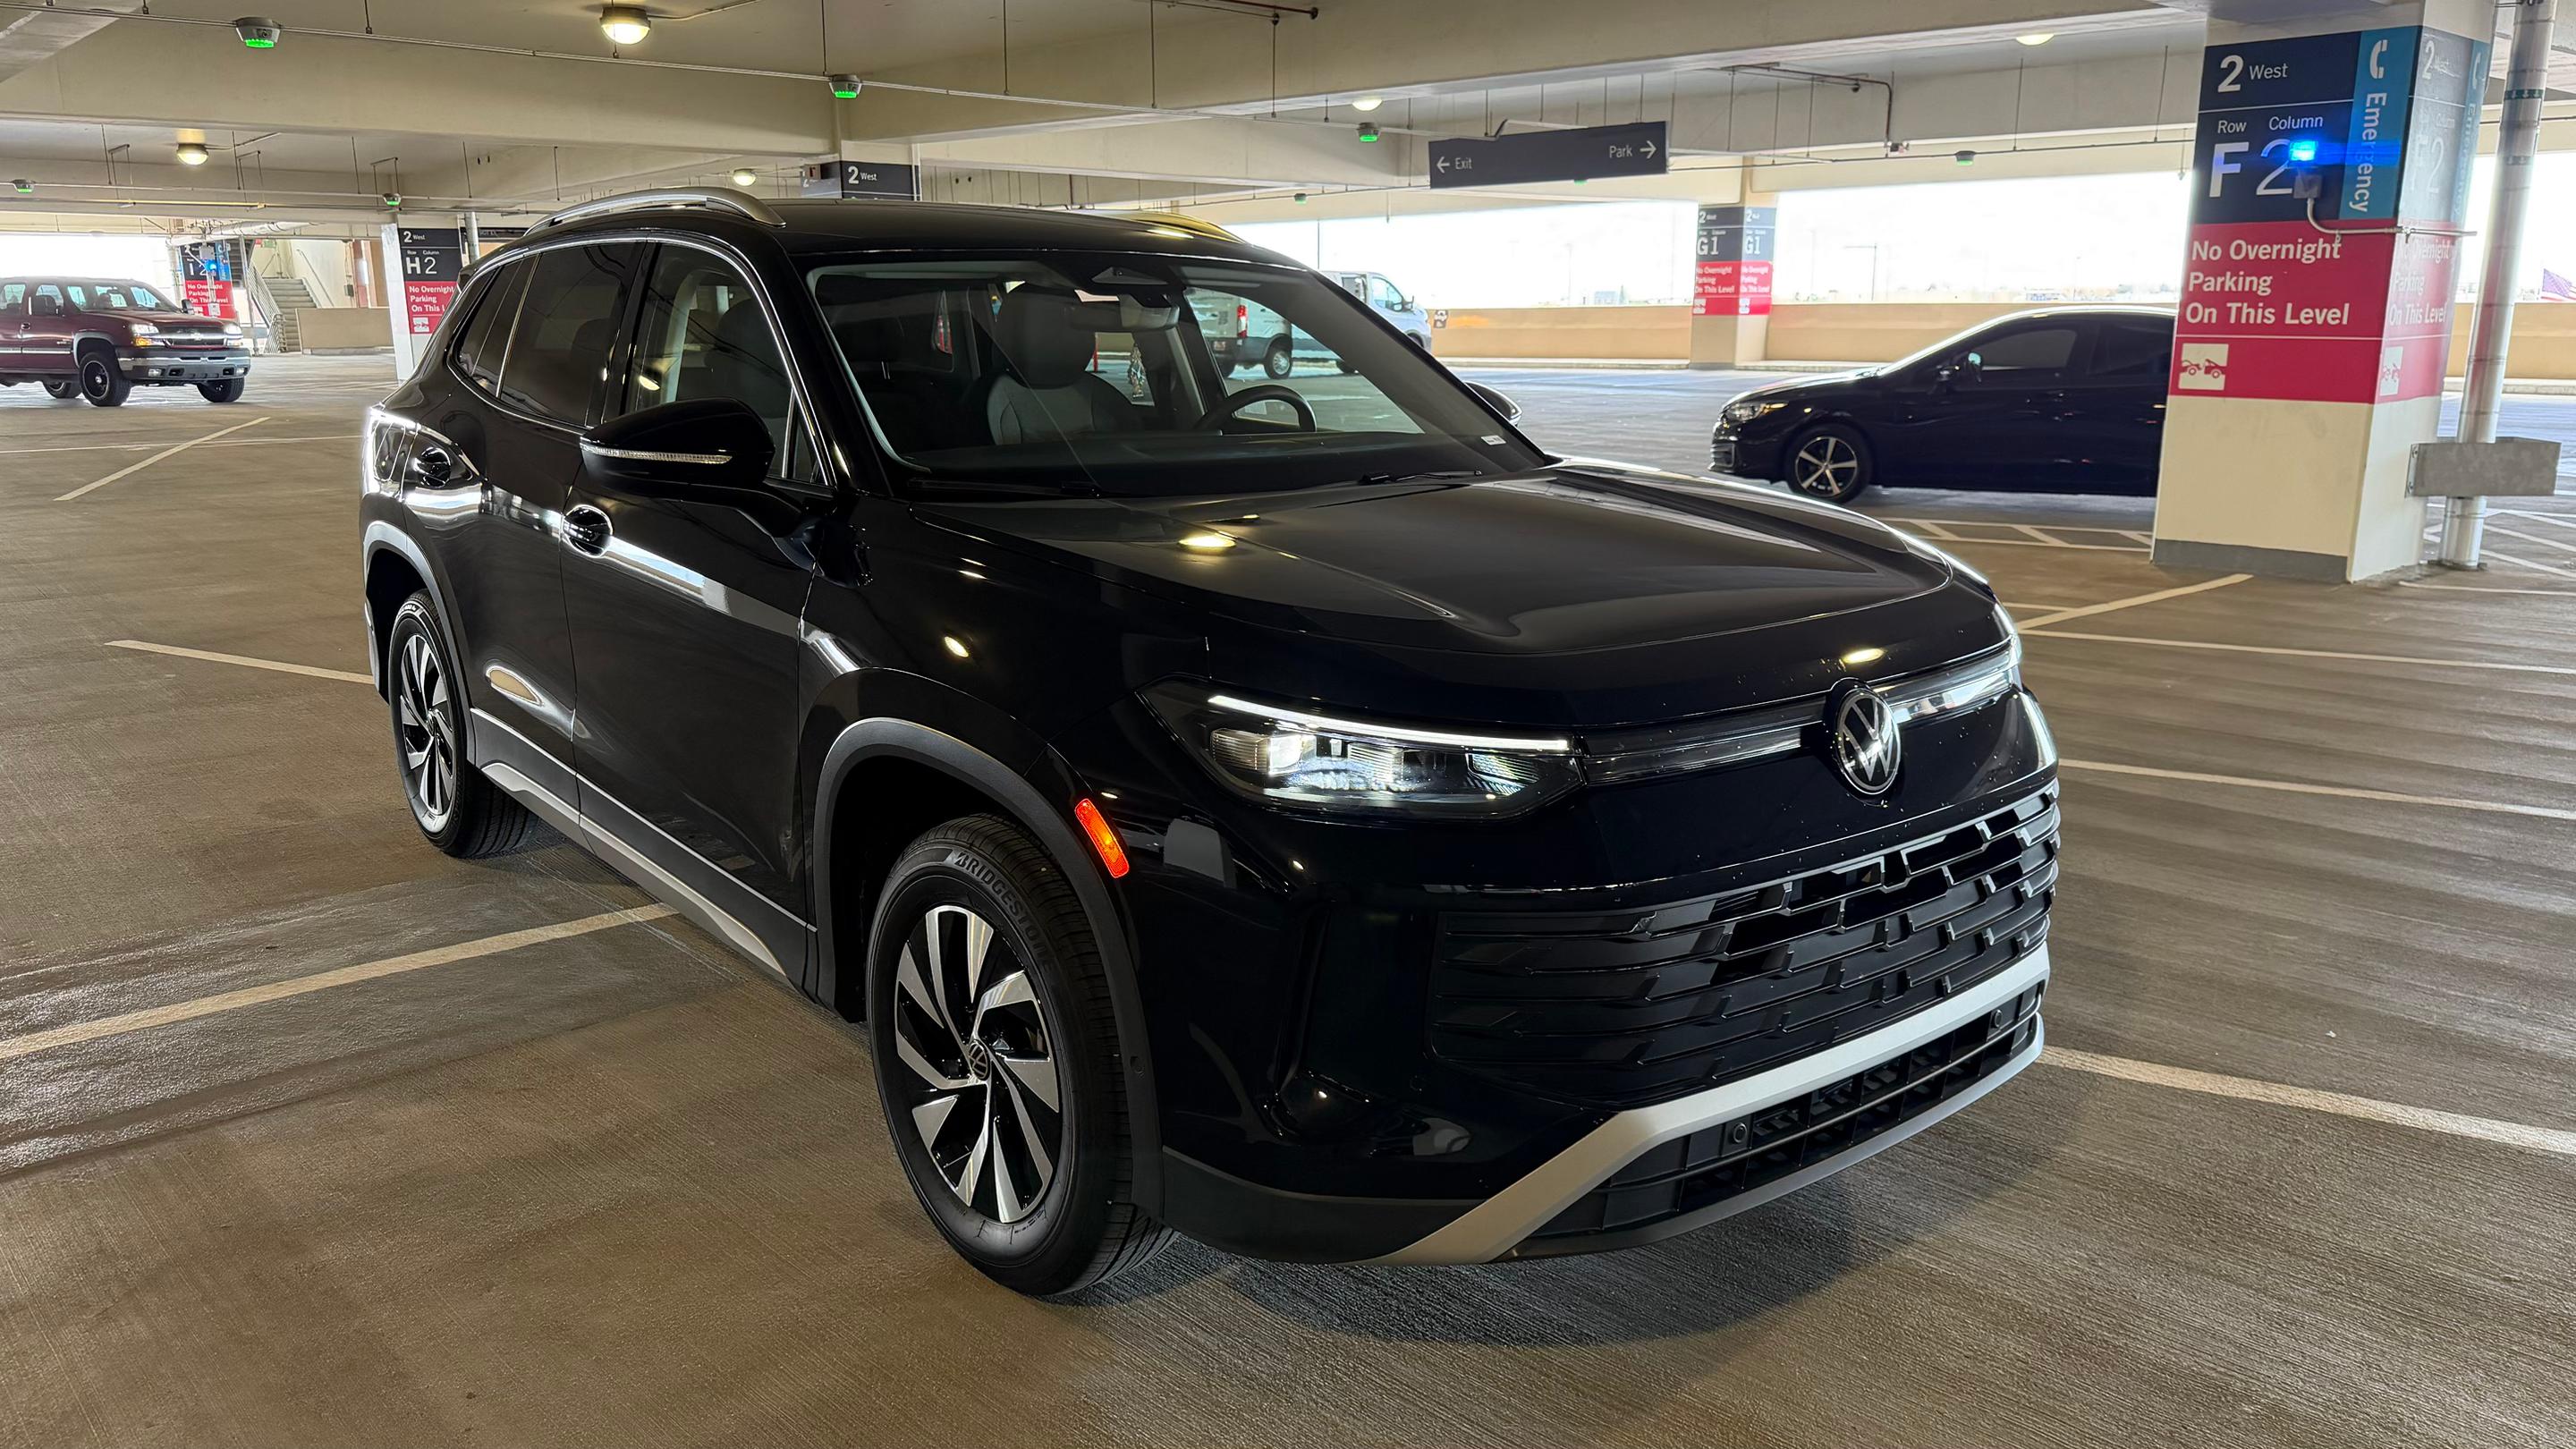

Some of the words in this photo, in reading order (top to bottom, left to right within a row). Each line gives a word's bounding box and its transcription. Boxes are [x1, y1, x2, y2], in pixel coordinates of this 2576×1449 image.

[2422, 40, 2435, 80] 2
[2217, 55, 2244, 93] 2
[2249, 64, 2289, 80] West
[2217, 121, 2247, 133] Row
[2268, 115, 2324, 131] Column
[1609, 145, 1633, 158] Park
[2349, 92, 2387, 212] Emergency
[1455, 157, 1472, 170] Exit
[2209, 141, 2250, 198] F
[848, 165, 859, 184] 2
[860, 172, 877, 181] West
[1699, 210, 1707, 224] 2
[403, 231, 412, 242] 2
[2192, 240, 2222, 260] No
[2229, 237, 2342, 264] Overnight
[405, 257, 421, 275] H
[424, 257, 437, 275] 2
[409, 285, 419, 293] No
[420, 285, 454, 294] Overnight
[2188, 271, 2273, 296] Parking
[411, 295, 437, 303] Parking
[2185, 302, 2217, 324] On
[2226, 301, 2275, 325] This
[2284, 302, 2350, 325] Level
[2389, 303, 2402, 326] On
[2404, 303, 2422, 325] This
[2425, 302, 2448, 324] Level
[953, 851, 1054, 971] BRIDGESTONE
